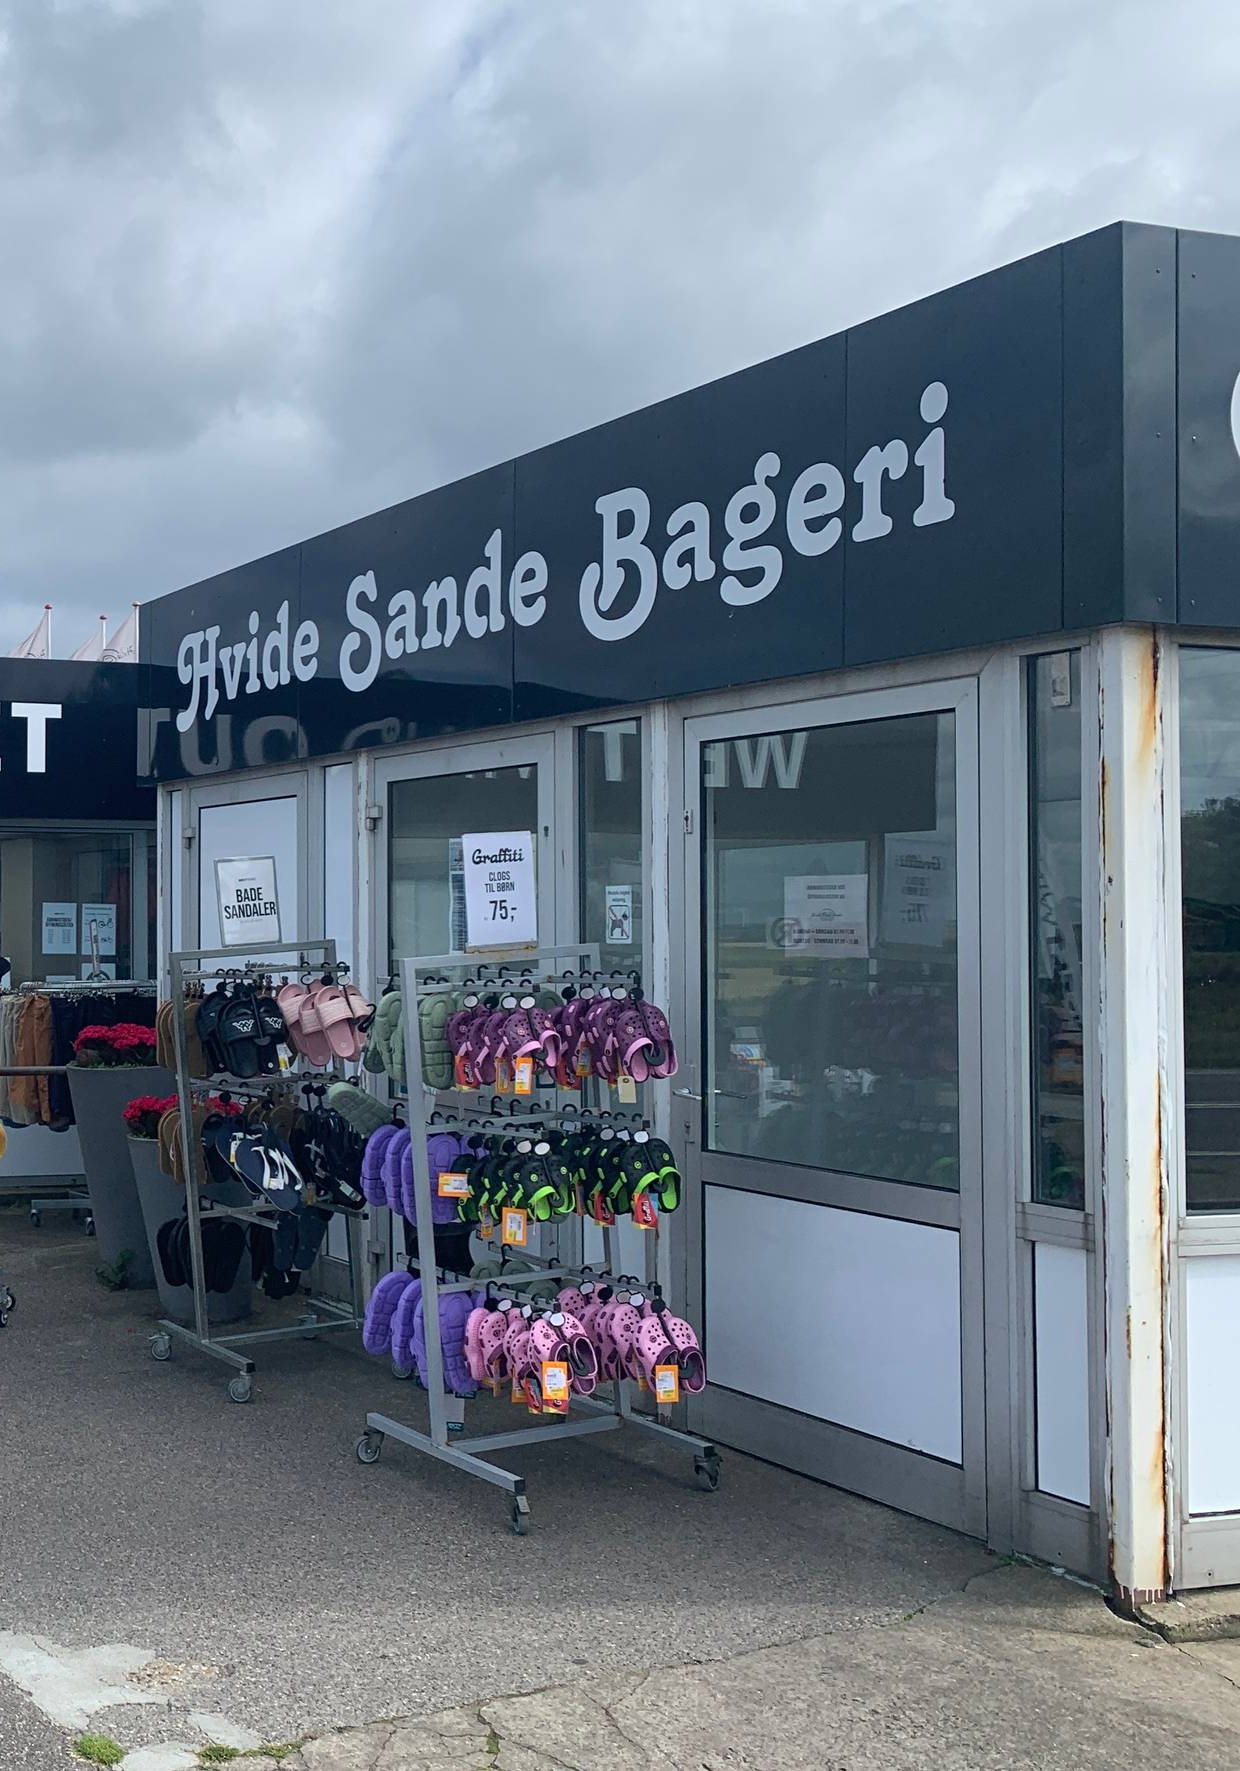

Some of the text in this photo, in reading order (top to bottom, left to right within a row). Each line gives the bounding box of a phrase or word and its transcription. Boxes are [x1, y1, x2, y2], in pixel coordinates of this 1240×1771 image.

[175, 381, 956, 733] Hvide Sande Bageri
[471, 848, 525, 865] Graffiti
[488, 871, 511, 882] CLOGS
[236, 887, 263, 903] BADE
[484, 882, 515, 893] TIL BØRN
[224, 901, 276, 919] SANDALER
